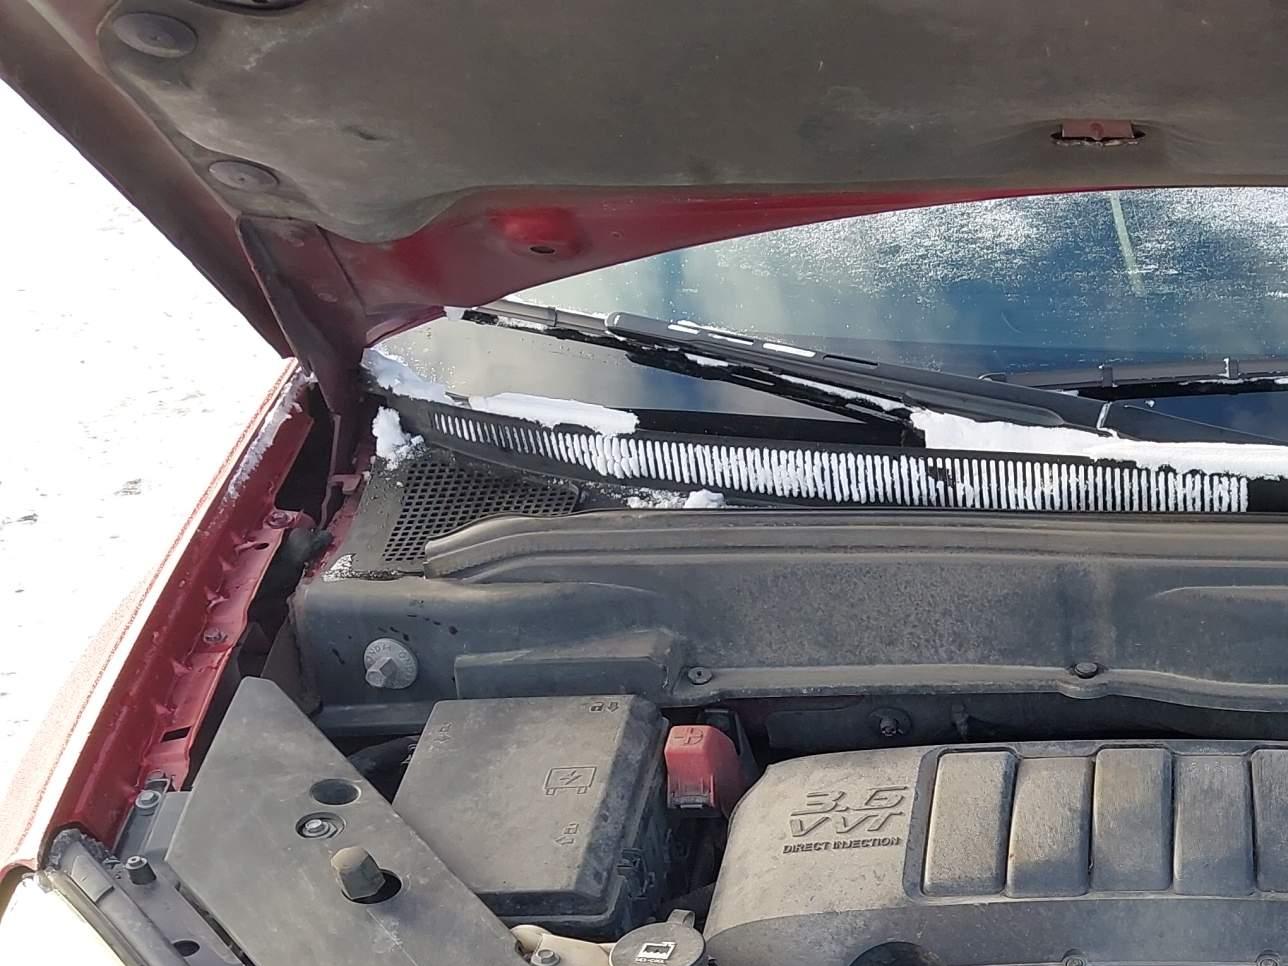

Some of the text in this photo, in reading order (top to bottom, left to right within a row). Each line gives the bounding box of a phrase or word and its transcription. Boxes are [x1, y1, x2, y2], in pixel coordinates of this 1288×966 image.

[790, 785, 908, 816] 3.6
[789, 811, 904, 838] VVT
[783, 836, 902, 855] DIRECT INJECTION
